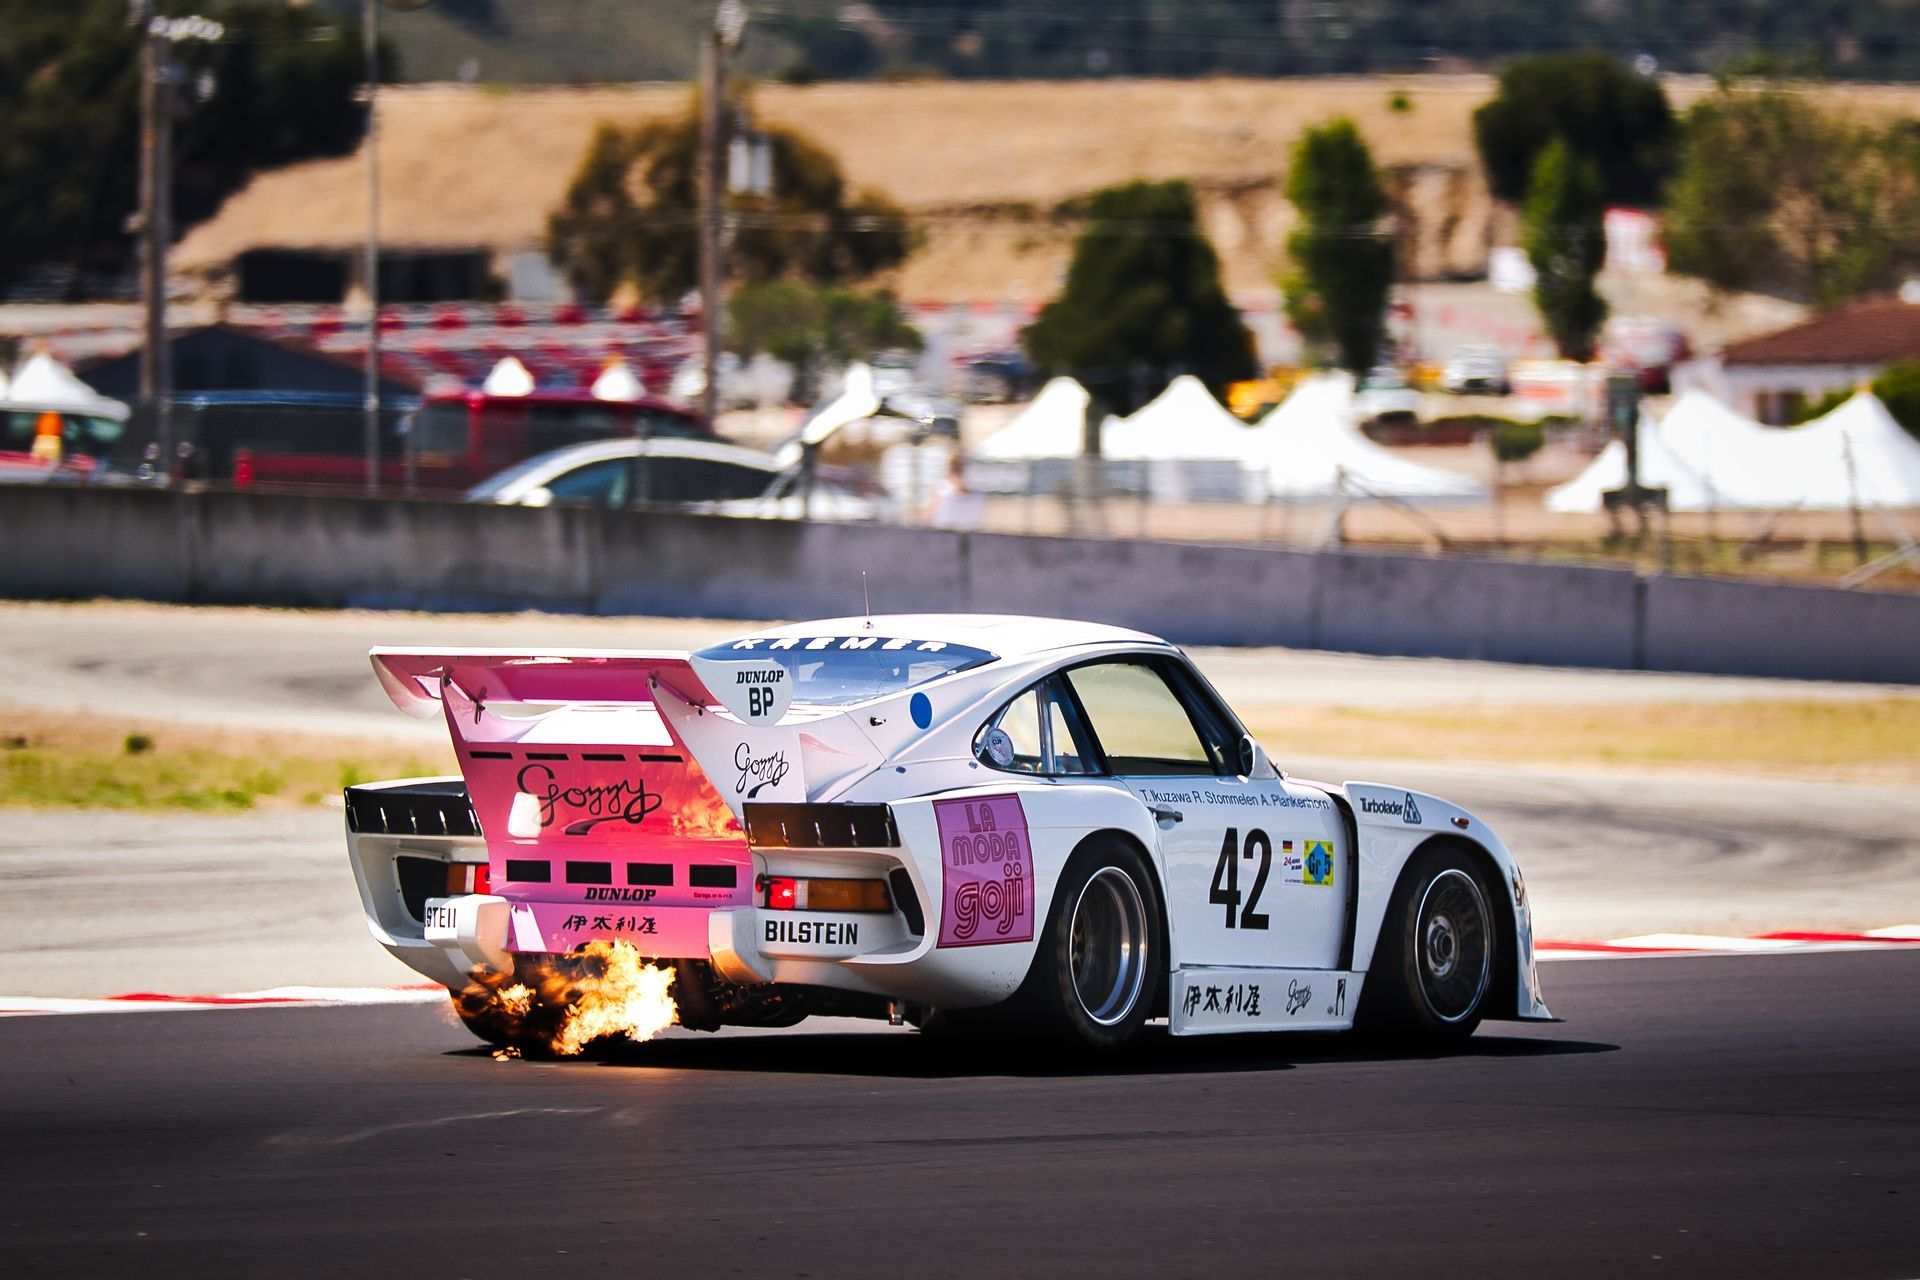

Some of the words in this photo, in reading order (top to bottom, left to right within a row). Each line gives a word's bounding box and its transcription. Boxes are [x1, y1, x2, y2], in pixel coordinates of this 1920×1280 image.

[732, 636, 948, 652] KREMER
[736, 670, 784, 684] DUNLOP
[749, 687, 774, 717] BP
[1192, 790, 1205, 804] R.
[1205, 792, 1259, 806] Stommelen
[1261, 794, 1271, 806] A.
[1273, 795, 1330, 810] Plankenhorn
[1360, 797, 1403, 815] Turbolader
[965, 802, 997, 833] LA
[952, 830, 1022, 866] MODA
[1324, 854, 1331, 876] 5
[1209, 827, 1272, 930] 42
[584, 887, 656, 901] DUNLOP
[953, 863, 1024, 940] goji
[765, 920, 858, 945] BILSTEIN
